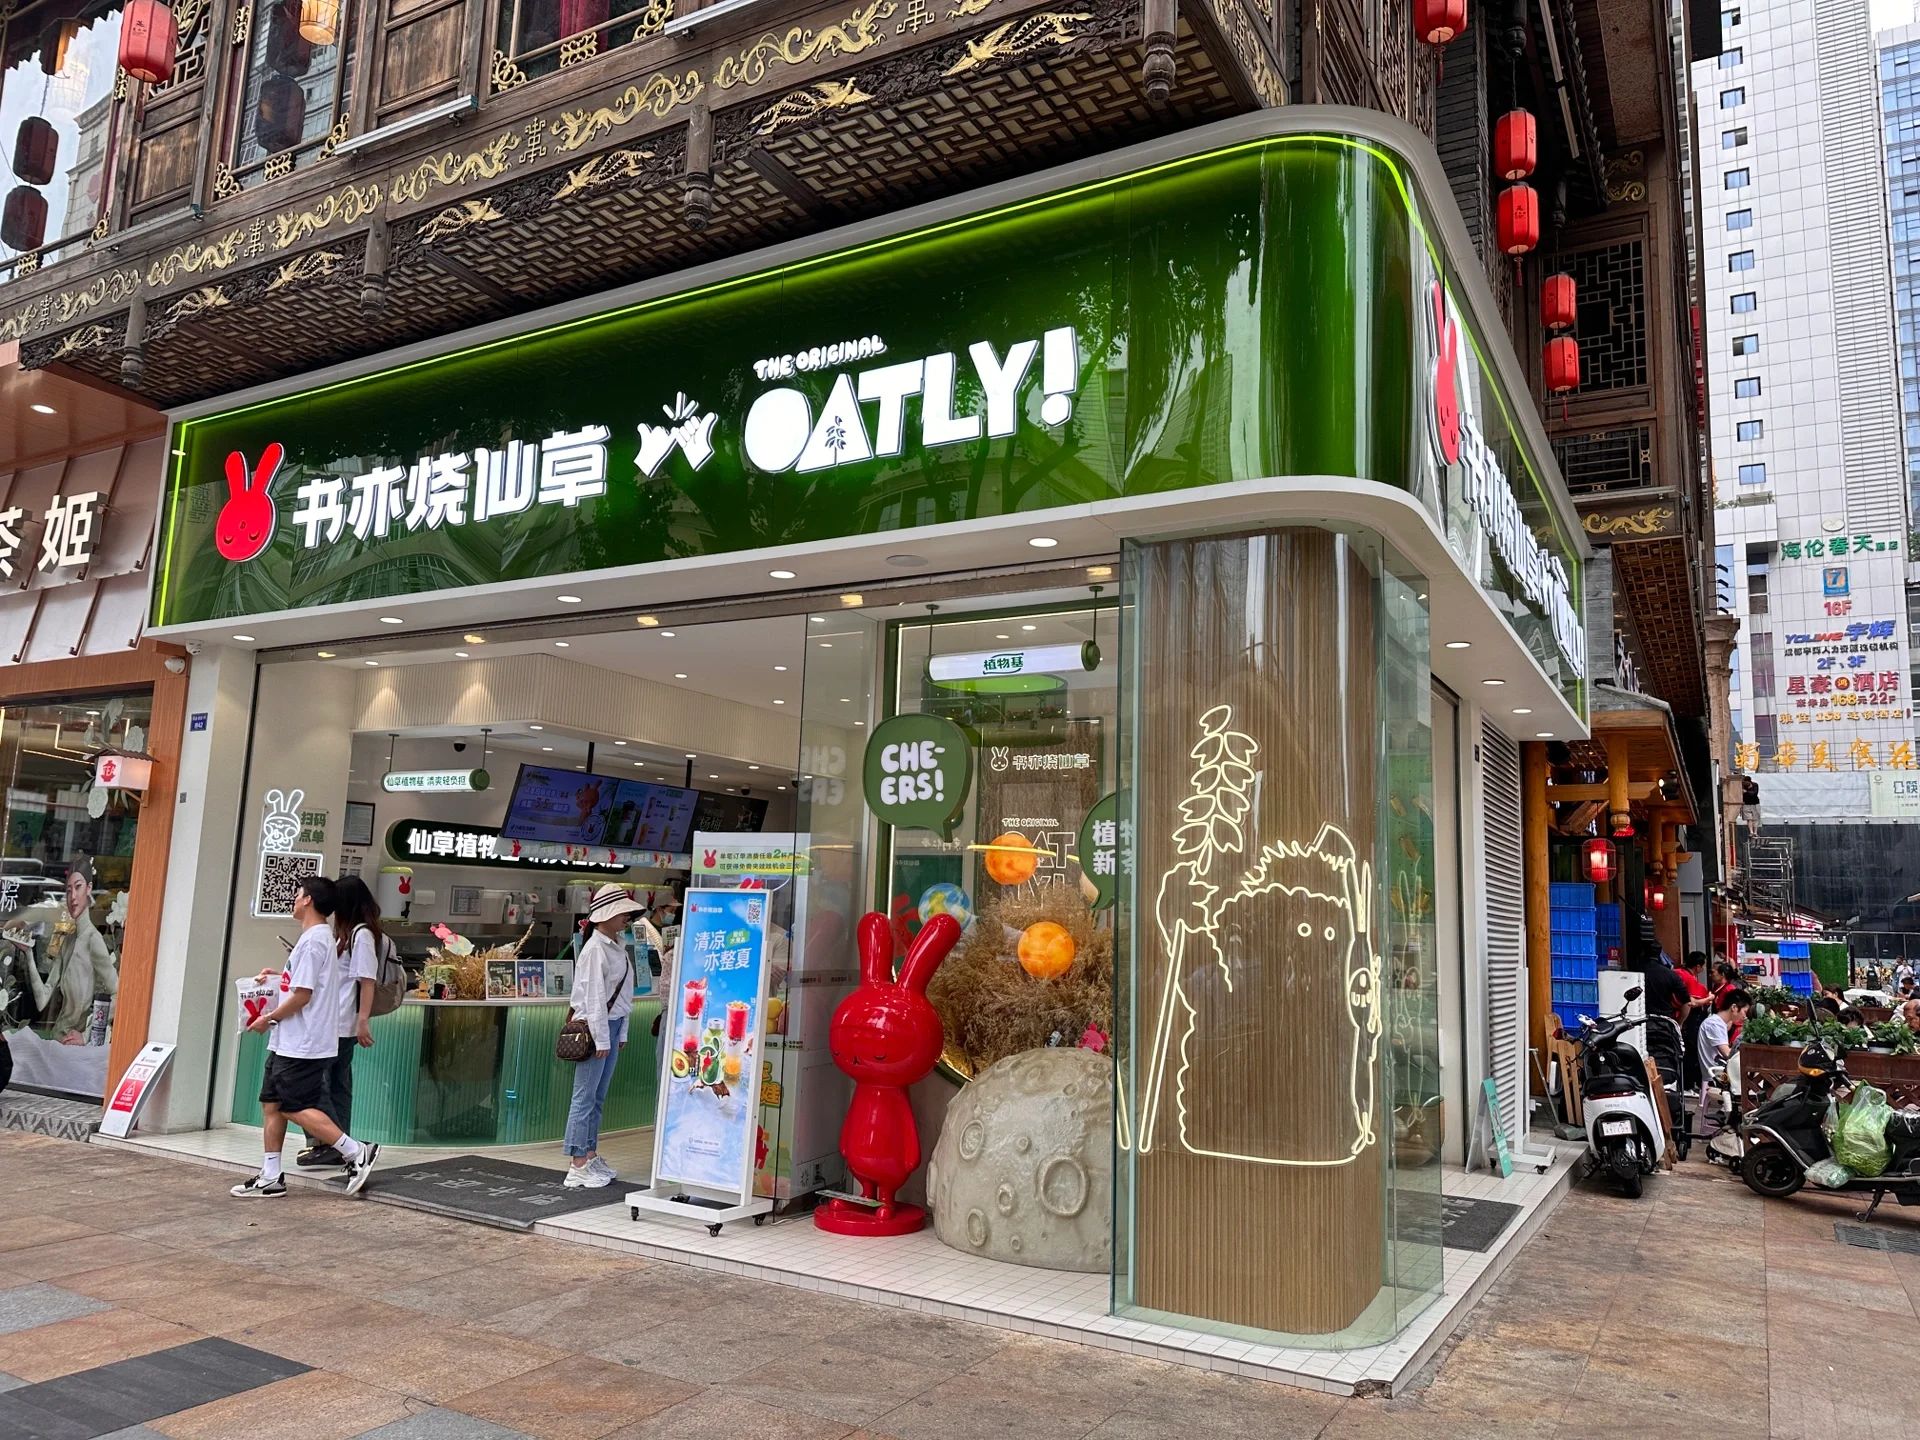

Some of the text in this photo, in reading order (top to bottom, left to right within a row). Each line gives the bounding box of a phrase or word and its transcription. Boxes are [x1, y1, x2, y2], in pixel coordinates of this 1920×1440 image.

[753, 334, 887, 381] THE ORIGINAL
[744, 326, 1080, 473] OATLY!
[292, 424, 612, 550] 书亦烧仙草
[1823, 600, 1852, 616] 16F
[983, 654, 1024, 672] 植物基
[1787, 674, 1832, 696] 星豪
[1853, 671, 1899, 692] 酒店
[1012, 752, 1091, 771] 书亦烧仙草
[880, 769, 945, 805] ERS!
[301, 811, 327, 828] 扫码
[1002, 817, 1060, 828] THE ORIGINAL
[299, 829, 325, 845] 点单
[694, 929, 727, 952] 清凉
[703, 947, 753, 973] 亦整夏
